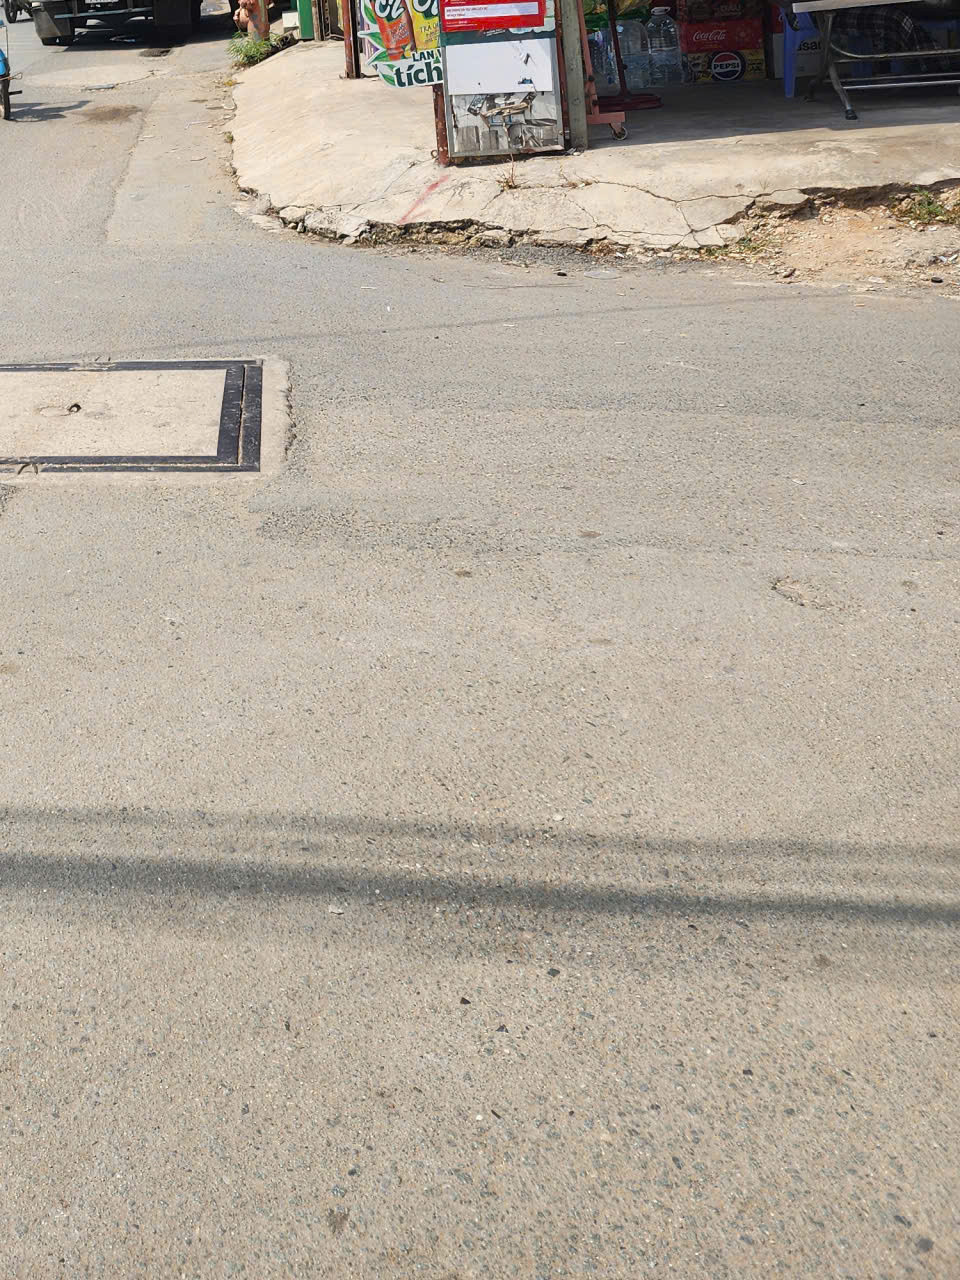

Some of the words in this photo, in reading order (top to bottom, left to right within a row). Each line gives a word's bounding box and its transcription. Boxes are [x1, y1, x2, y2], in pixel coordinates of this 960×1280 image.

[412, 50, 434, 62] LAN
[712, 62, 741, 71] PEPSI
[394, 62, 444, 87] tích
